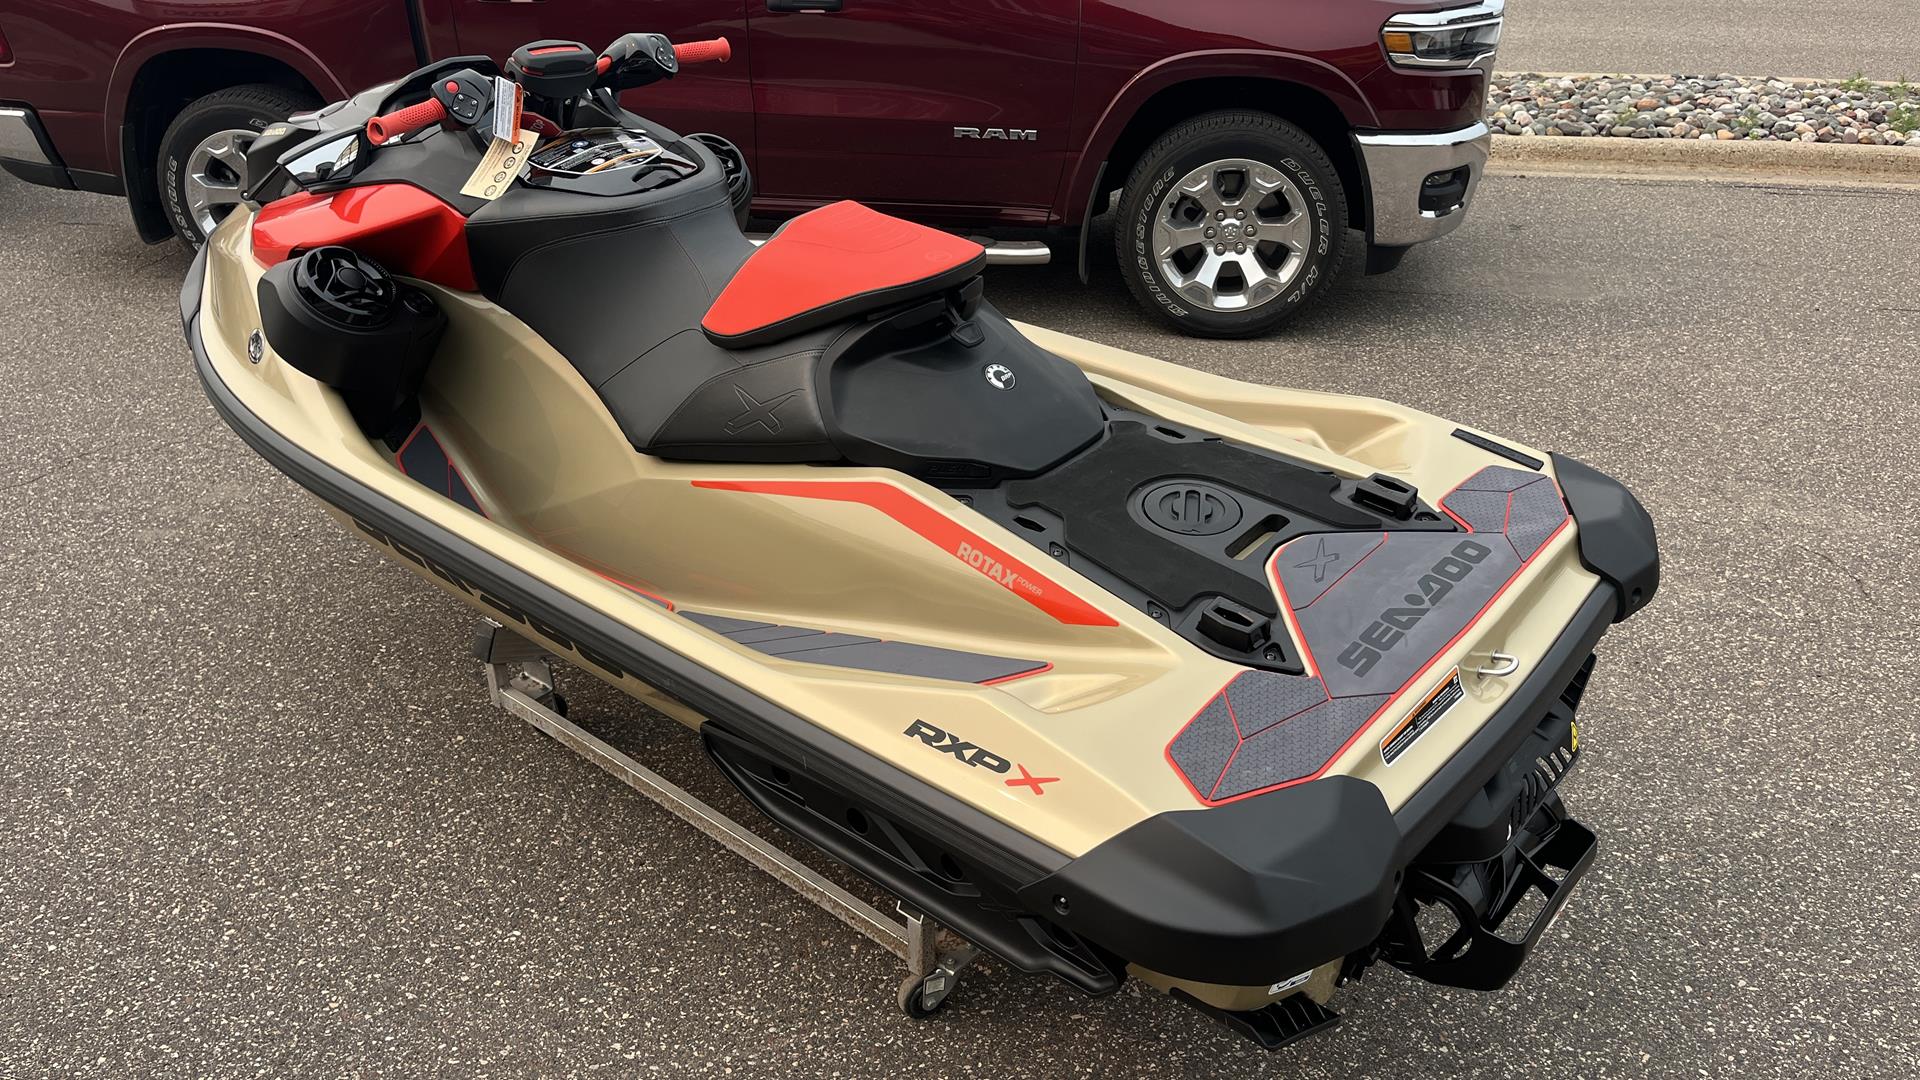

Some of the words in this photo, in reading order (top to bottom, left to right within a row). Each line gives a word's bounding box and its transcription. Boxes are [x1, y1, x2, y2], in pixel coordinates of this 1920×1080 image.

[954, 127, 1037, 141] RAM
[1280, 157, 1330, 256] DUELER
[1135, 166, 1189, 317] BRIDGESTONE
[1287, 265, 1319, 304] H/L
[956, 541, 1018, 590] ROTAX
[1016, 576, 1043, 596] POWER
[903, 718, 1012, 774] RXP
